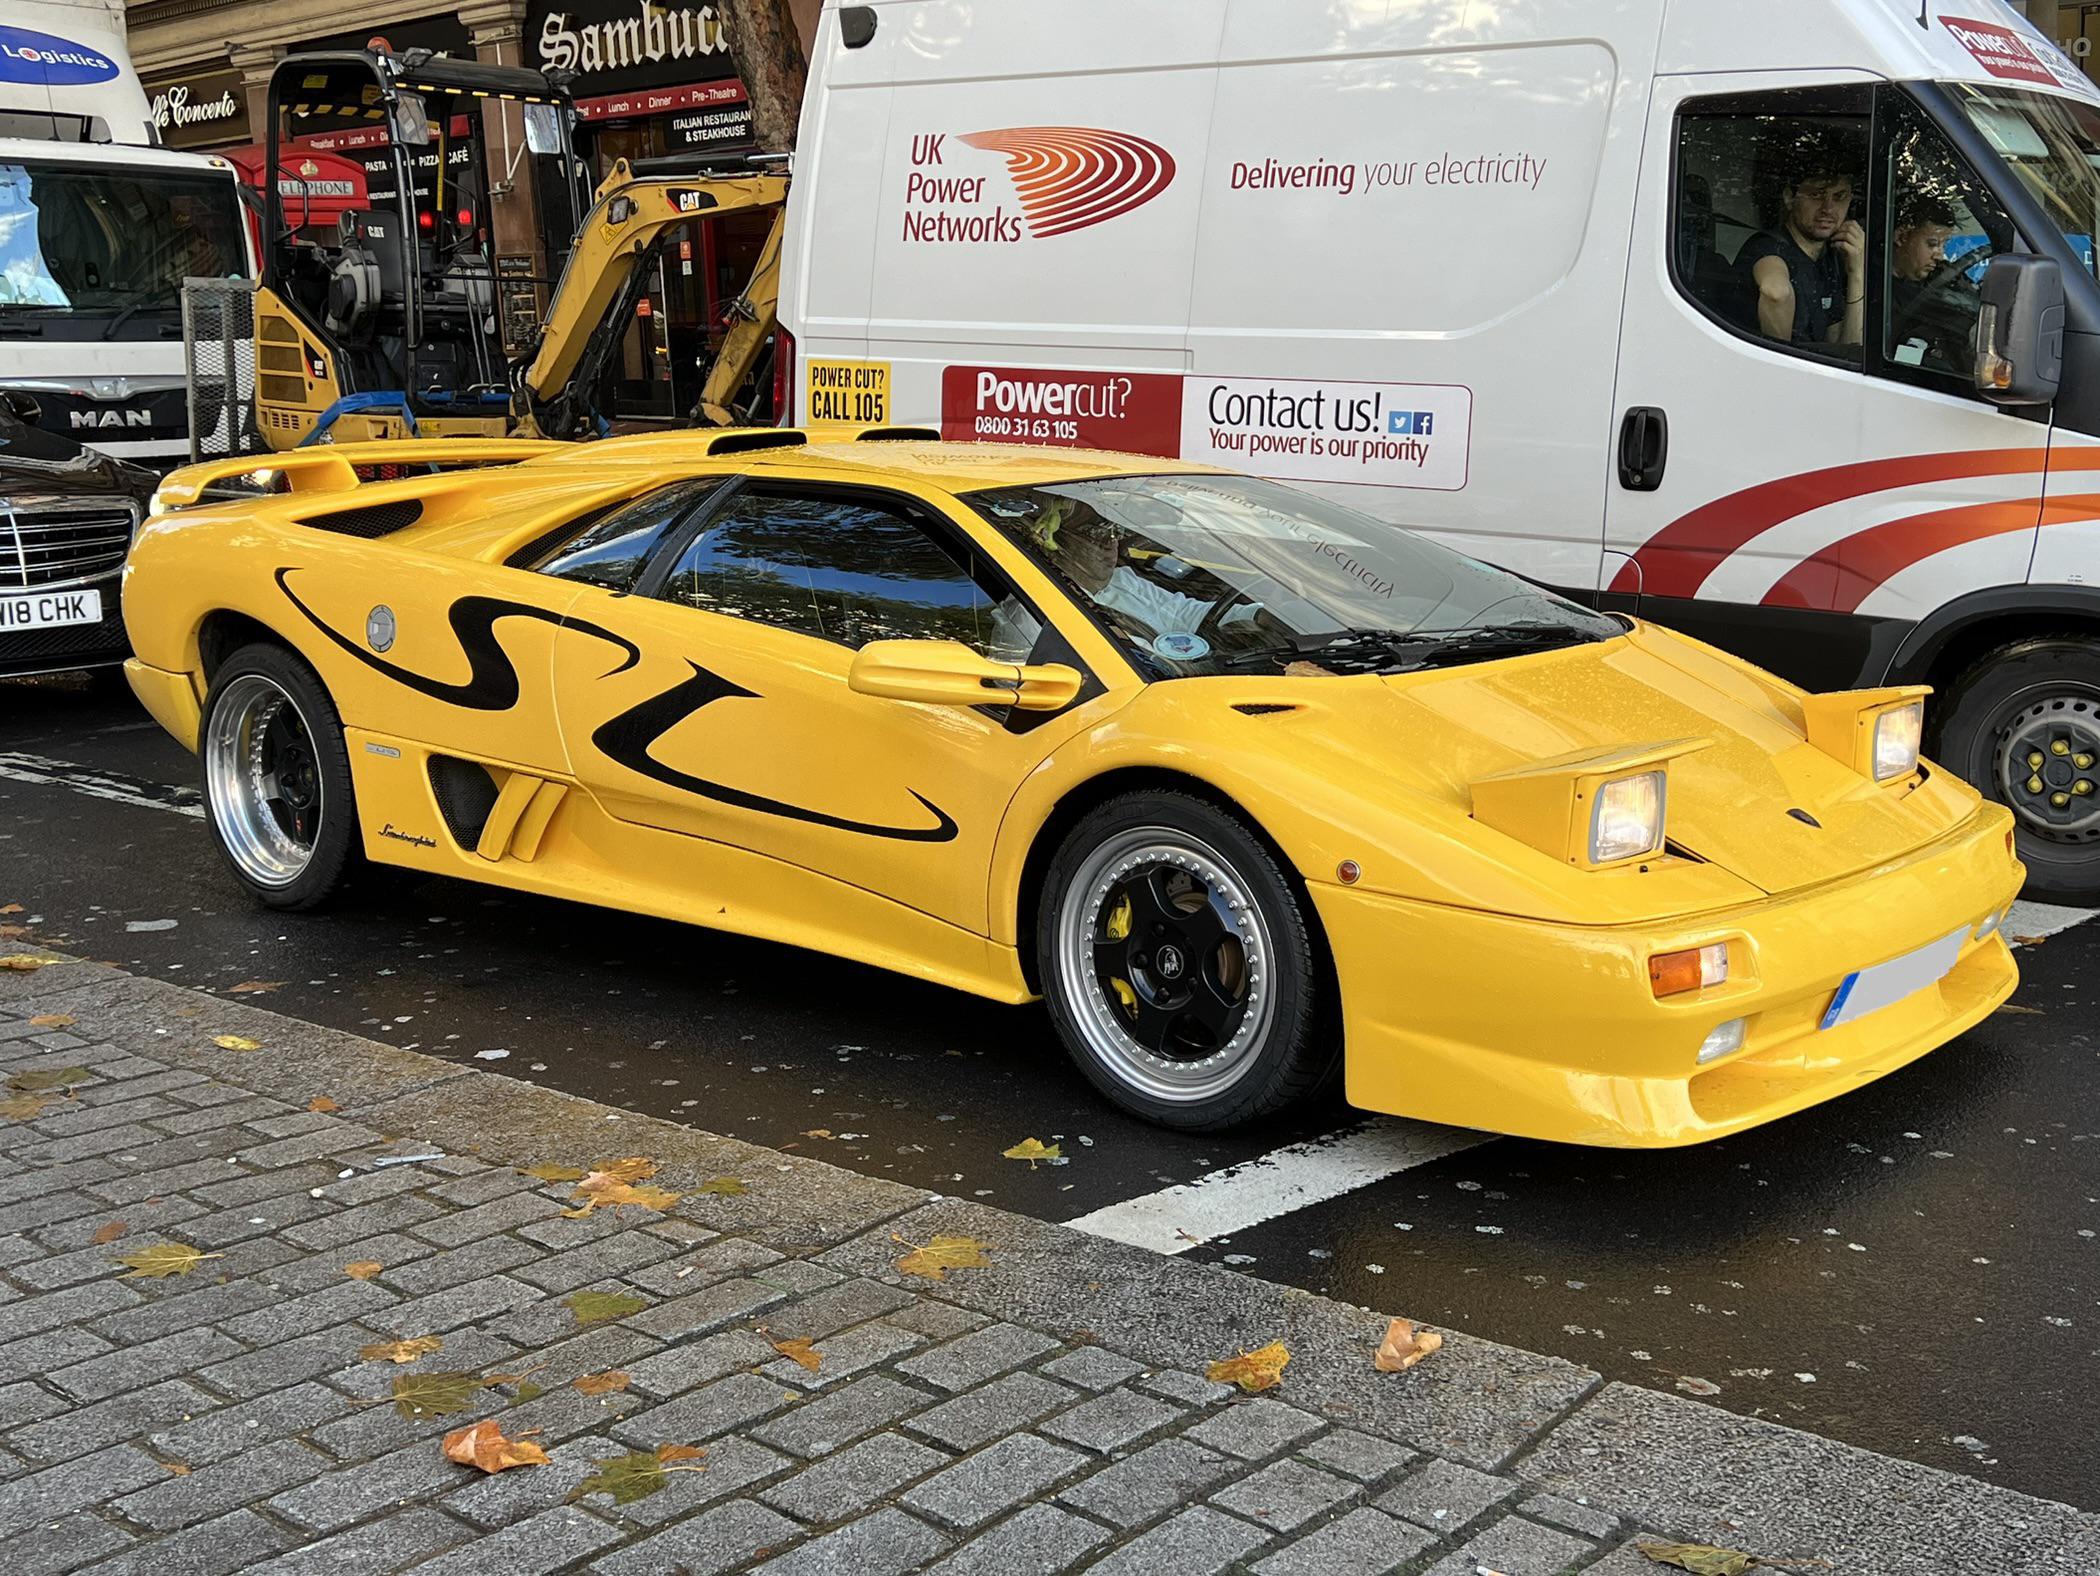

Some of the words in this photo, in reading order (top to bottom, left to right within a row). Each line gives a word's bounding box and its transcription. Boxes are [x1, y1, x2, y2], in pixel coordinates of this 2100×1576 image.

[539, 0, 728, 73] Sambuc
[2, 44, 109, 69] Logistics
[168, 86, 236, 128] Concerto
[608, 101, 629, 113] Lunch
[649, 96, 672, 109] Dinner
[692, 87, 737, 103] Pre-Theatre
[673, 115, 703, 131] ITALIAN
[703, 110, 752, 127] RESTAURAN
[685, 131, 693, 143] &
[692, 125, 746, 142] STEAKHOUSE
[911, 133, 946, 165] UK
[365, 160, 387, 172] PASTA
[418, 155, 440, 168] PIZZA
[1230, 158, 1355, 194] Delivering
[1364, 161, 1418, 194] your
[1425, 152, 1547, 191] electricity
[280, 181, 352, 196] ELEPHONE
[906, 172, 986, 203] Power
[680, 192, 700, 211] CAT
[367, 225, 385, 238] CAT
[903, 206, 1022, 242] Networks
[812, 366, 852, 388] POWER
[855, 368, 885, 390] CUT?
[812, 390, 851, 420] CALL
[855, 392, 884, 423] 105
[976, 371, 1132, 419] Powercut?
[69, 409, 152, 429] MAN
[1208, 385, 1326, 431] Contact
[1334, 391, 1382, 433] us!
[975, 415, 1011, 436] 0800
[1012, 417, 1029, 437] 31
[1032, 419, 1050, 438] 63
[1052, 420, 1078, 440] 105
[1208, 427, 1247, 450] Your
[1250, 433, 1307, 457] power
[1310, 431, 1324, 455] is
[1328, 438, 1360, 457] our
[1362, 436, 1429, 468] priority
[39, 595, 87, 622] CHK
